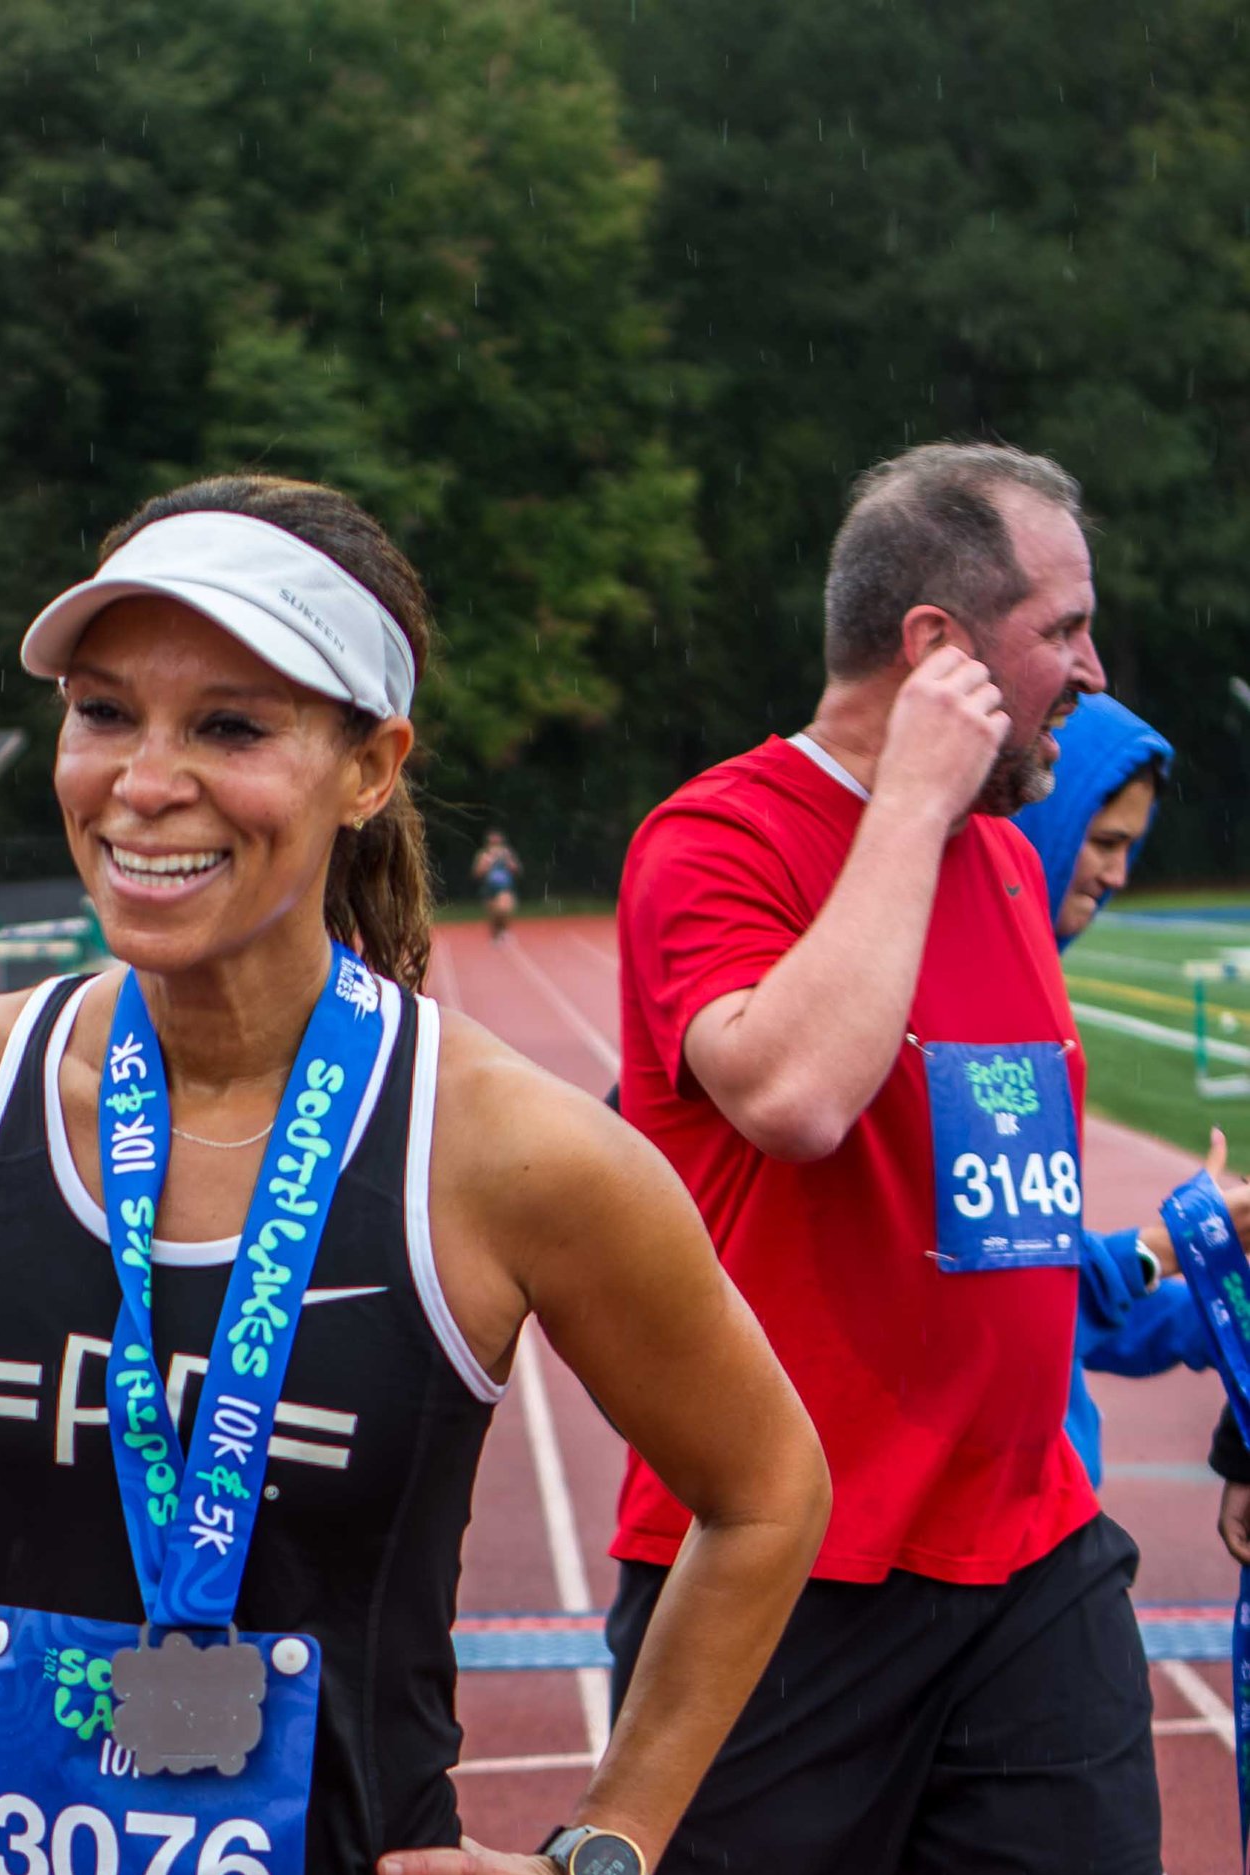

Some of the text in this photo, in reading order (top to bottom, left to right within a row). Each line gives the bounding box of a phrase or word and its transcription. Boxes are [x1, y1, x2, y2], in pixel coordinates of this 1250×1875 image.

[110, 1032, 147, 1084] 5K
[105, 1083, 157, 1115] &
[111, 1113, 156, 1174] 10K
[952, 1151, 1081, 1218] 3148
[188, 1058, 344, 1555] SOUTH LAKES 10K & 5K
[100, 1738, 139, 1779] 10
